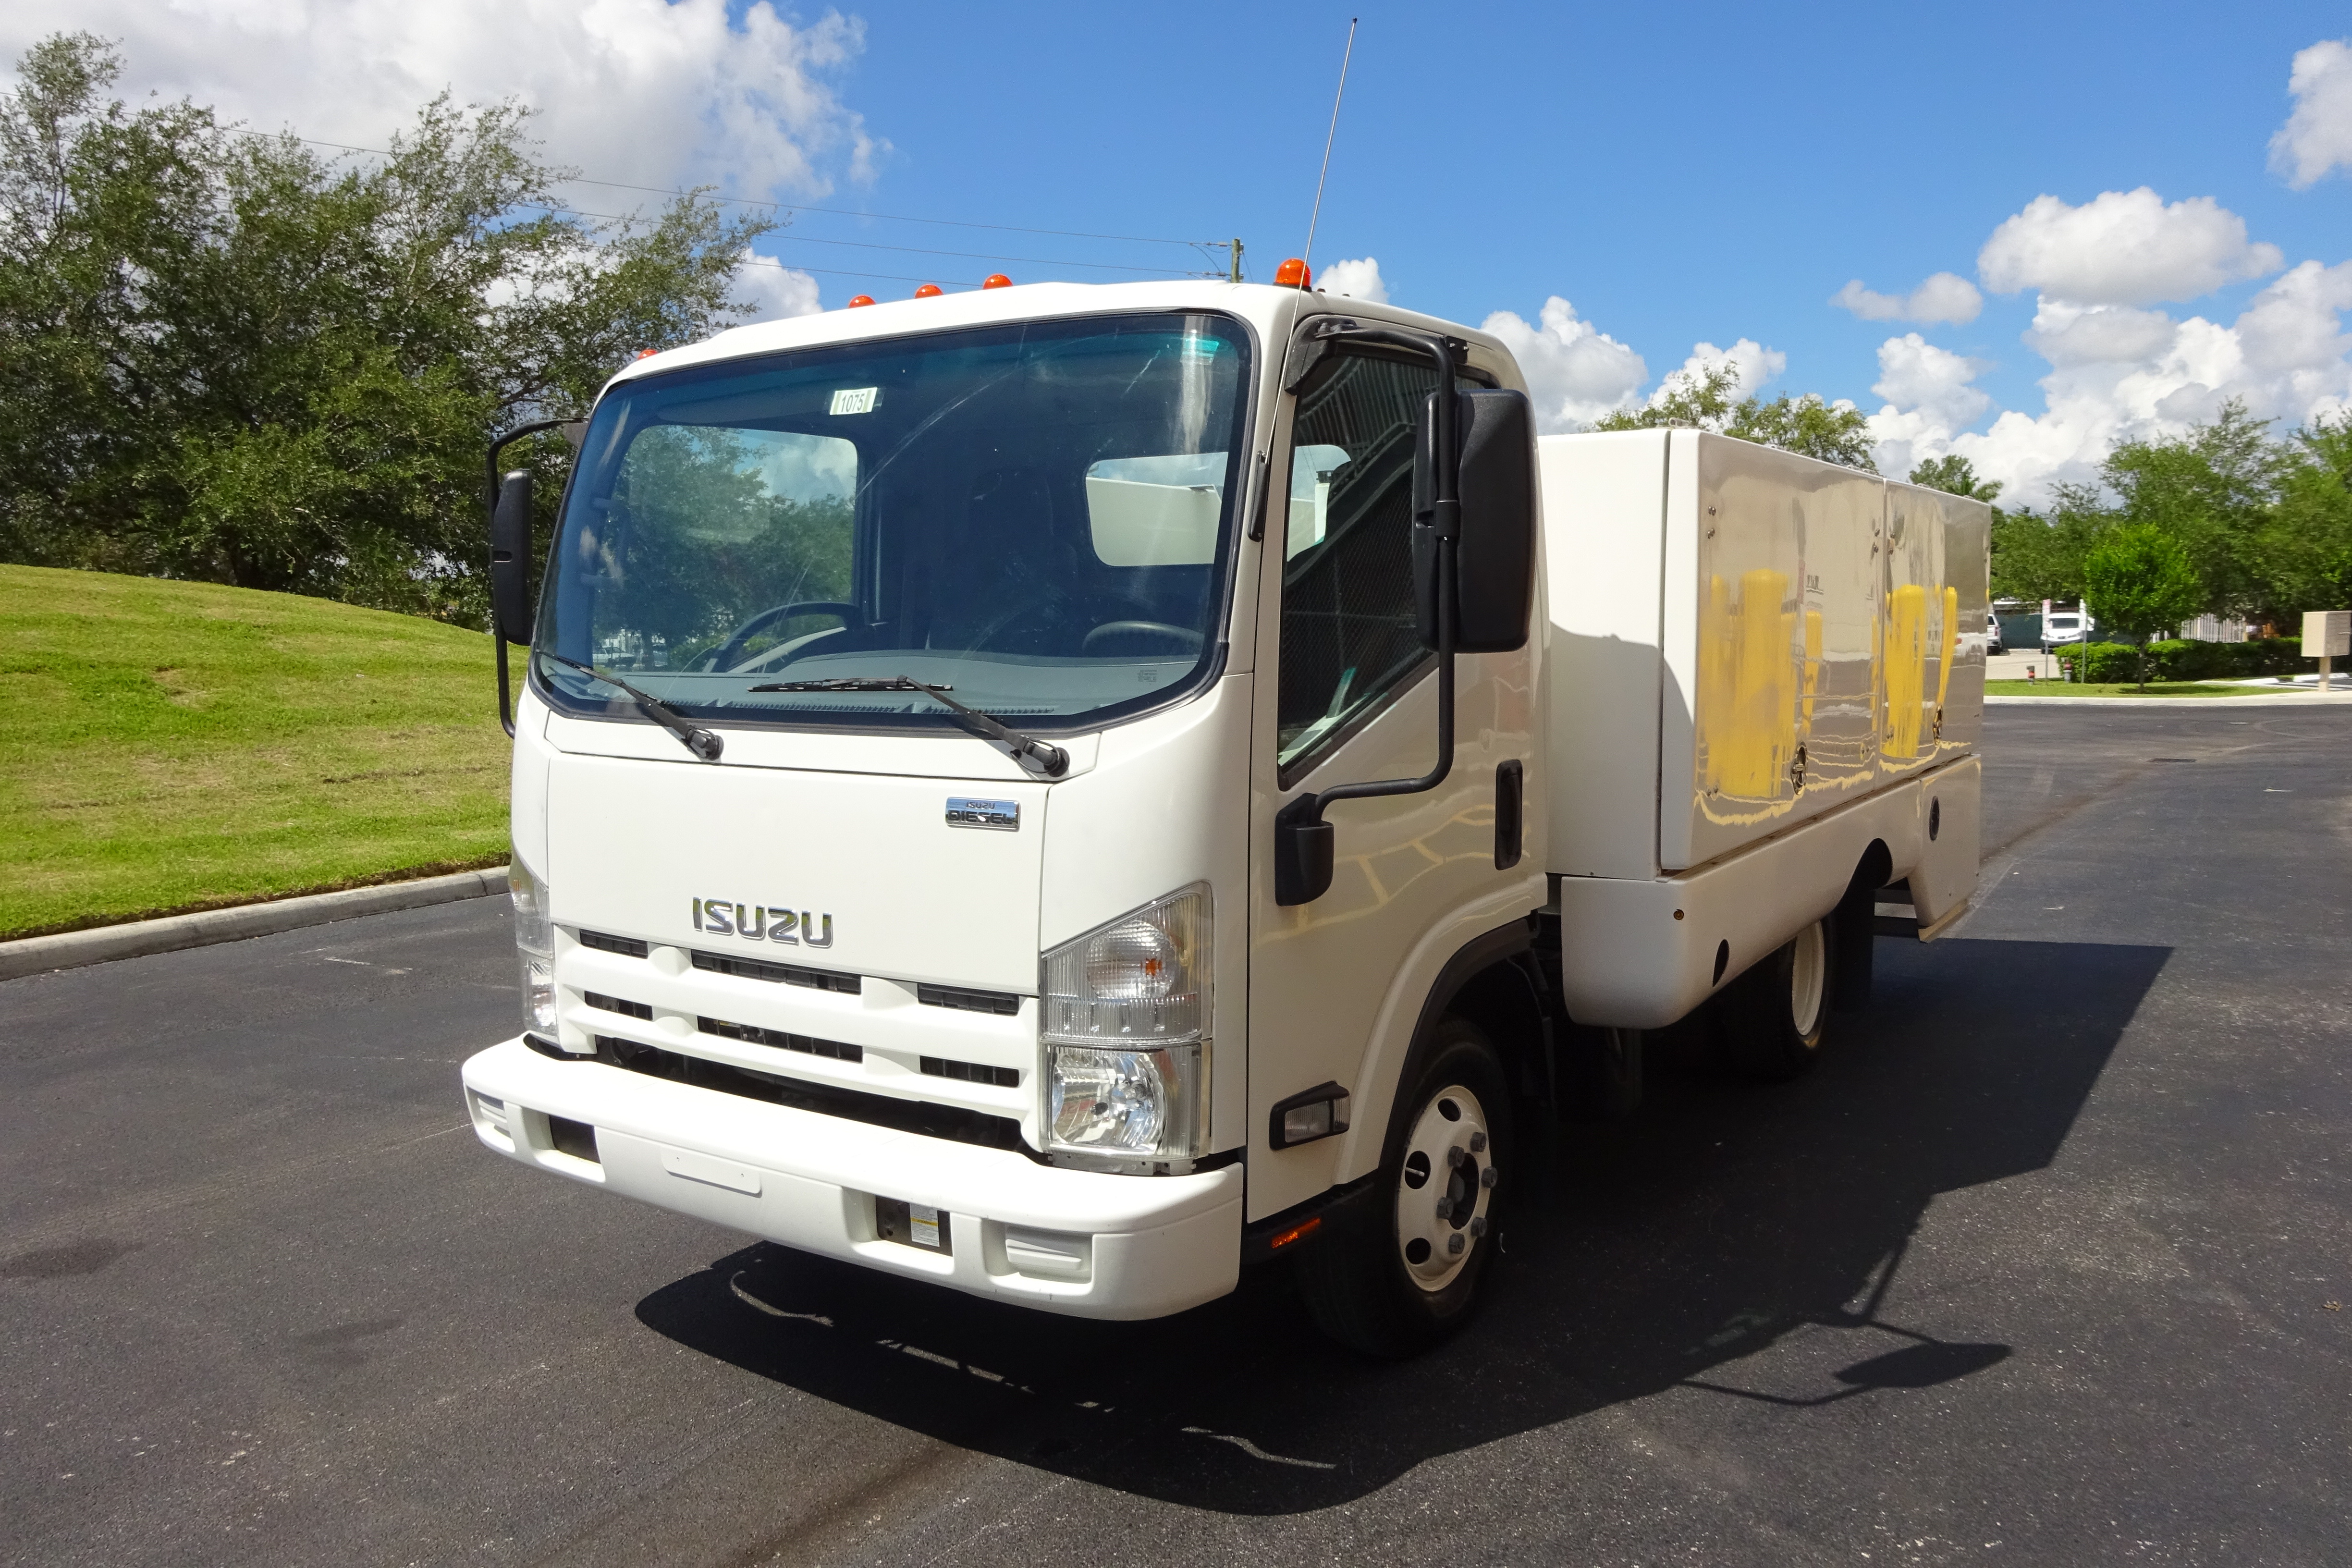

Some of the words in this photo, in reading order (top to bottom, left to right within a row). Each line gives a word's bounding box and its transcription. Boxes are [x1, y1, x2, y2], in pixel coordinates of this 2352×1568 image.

[841, 393, 865, 413] 1075
[966, 801, 996, 809] ISUZU
[948, 810, 1014, 825] DIESEL
[693, 896, 833, 949] ISUZU
